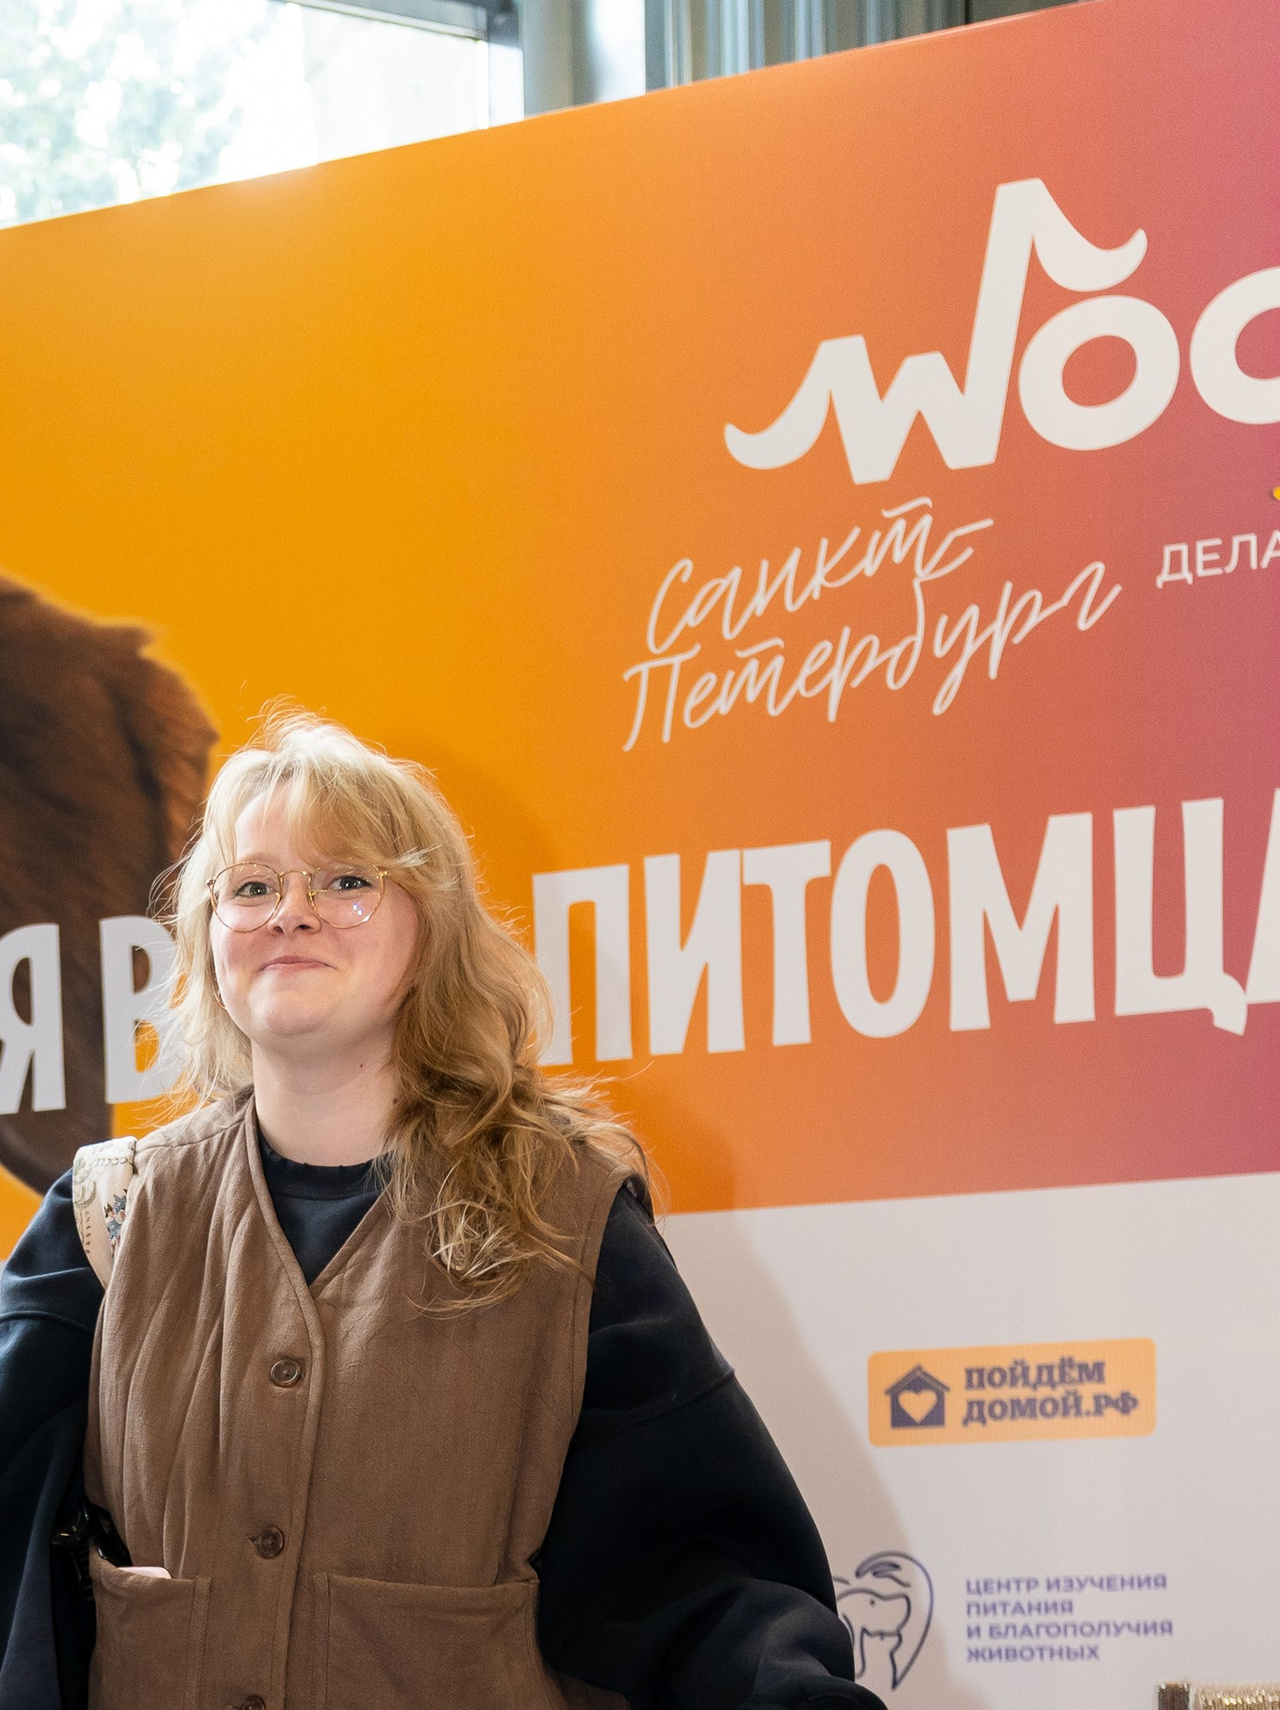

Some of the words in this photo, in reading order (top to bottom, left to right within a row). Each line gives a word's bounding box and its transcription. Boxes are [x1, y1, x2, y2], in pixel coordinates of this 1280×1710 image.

[964, 1356, 1106, 1391] ПОЙДЁМ
[962, 1388, 1139, 1427] ДОМОЙ.РФ
[966, 1577, 1040, 1596] ЦЕНТР
[1046, 1574, 1168, 1593] ИЗУЧЕНИЯ
[966, 1600, 1074, 1618] ПИТАНИЯ
[966, 1623, 982, 1639] И
[988, 1620, 1174, 1639] БЛАГОПОЛУЧИЯ
[966, 1645, 1100, 1663] ЖИВОТНЫХ
